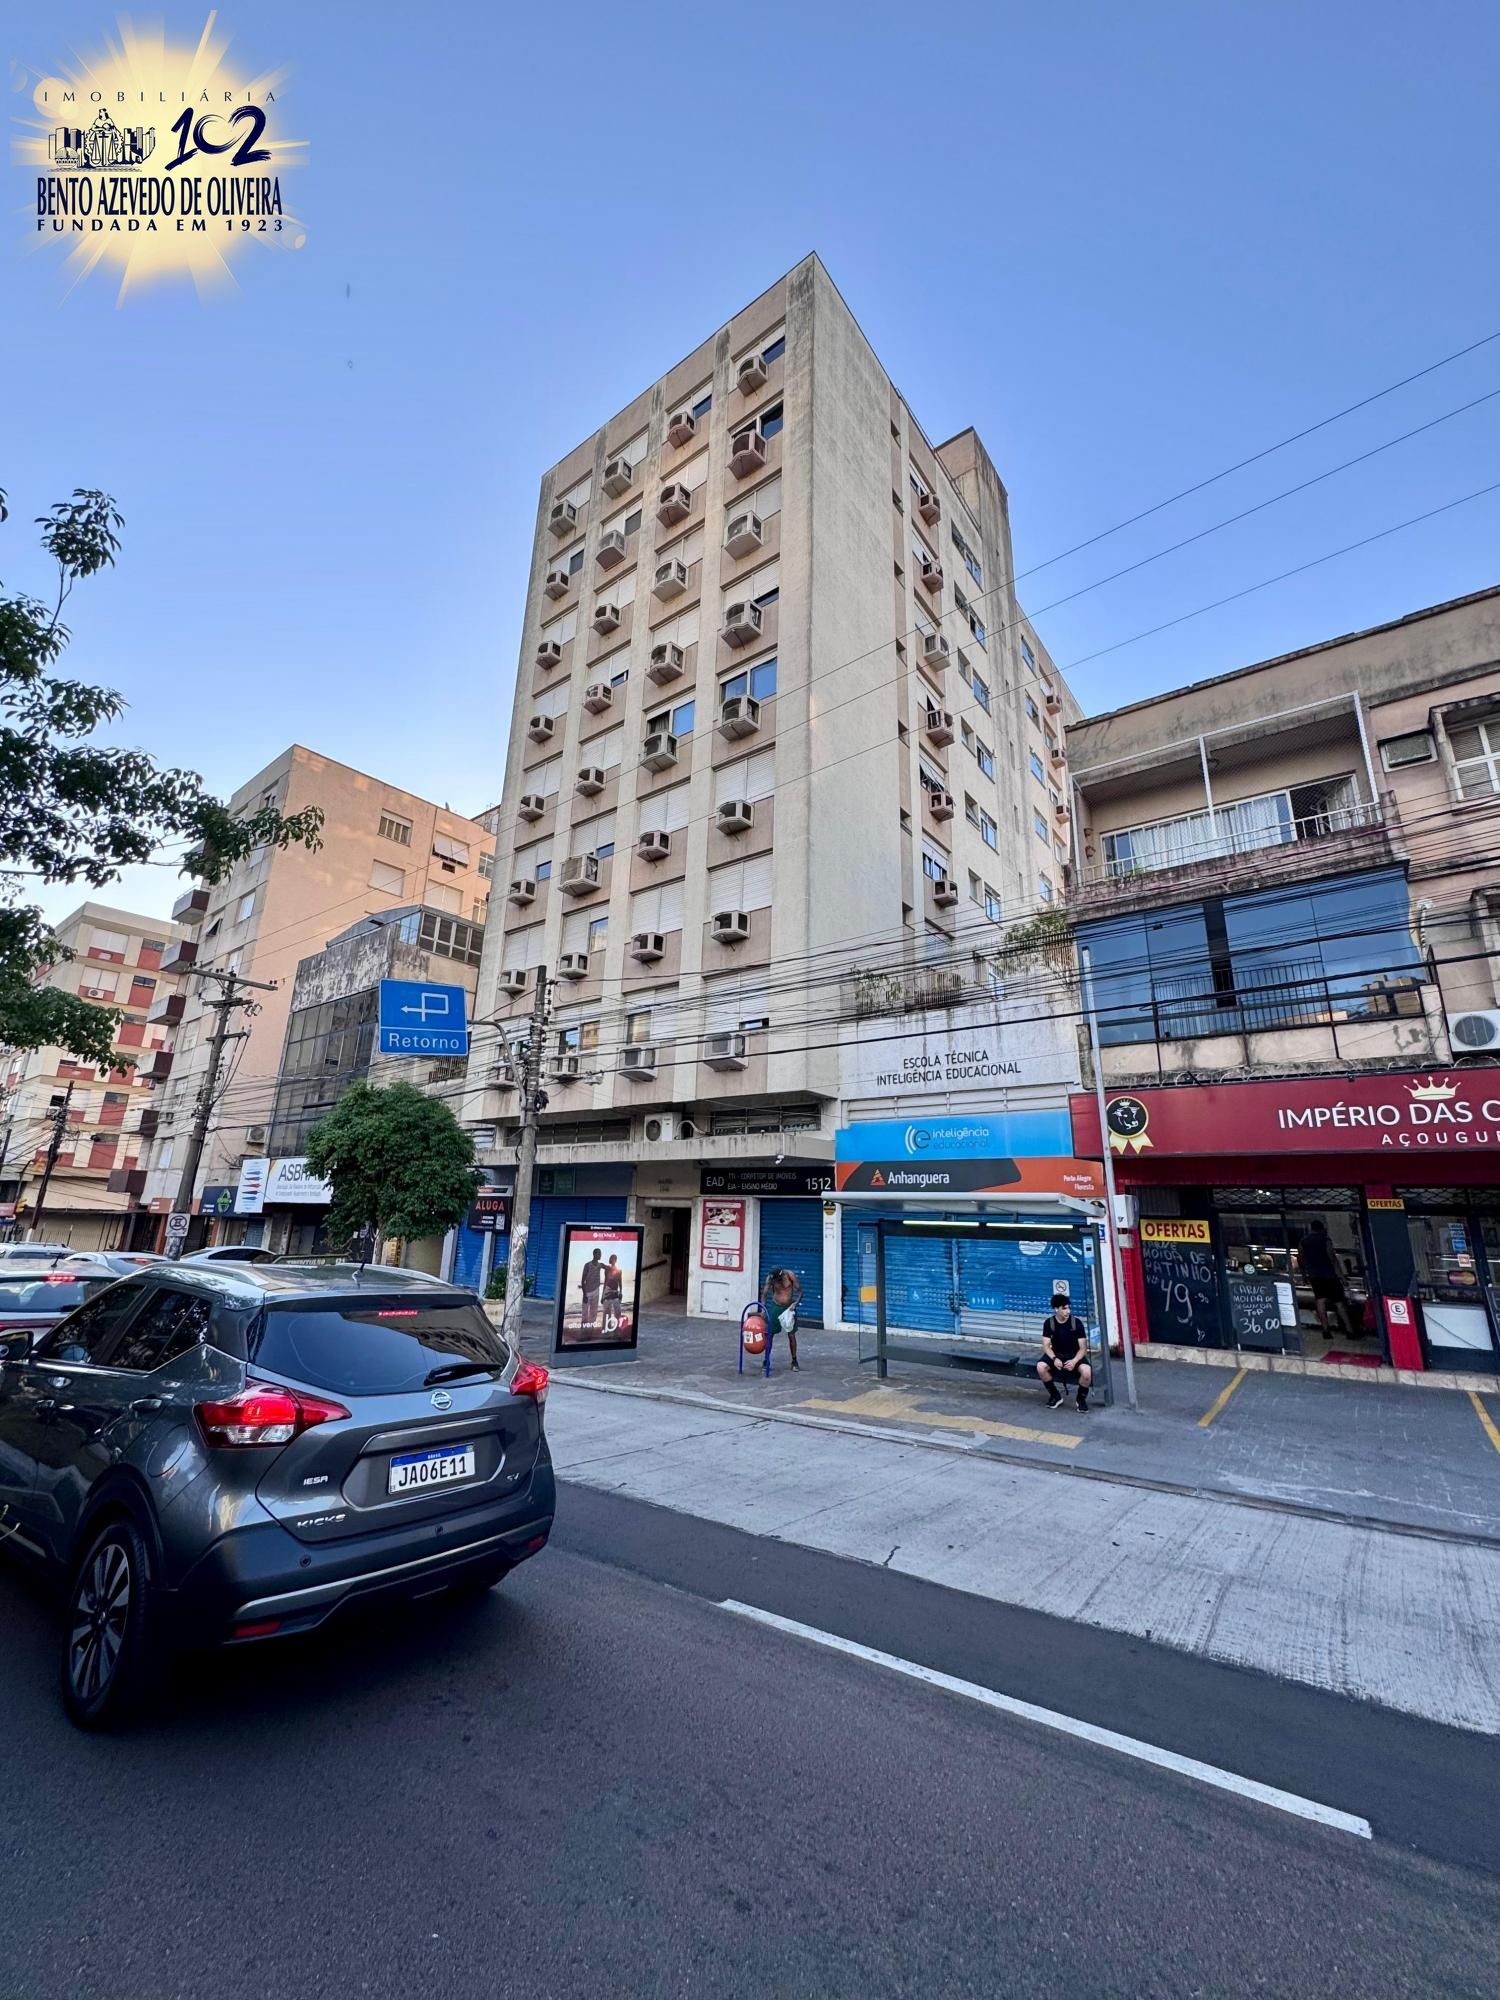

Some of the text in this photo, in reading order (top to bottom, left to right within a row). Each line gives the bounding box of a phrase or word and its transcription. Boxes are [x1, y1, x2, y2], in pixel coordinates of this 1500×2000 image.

[389, 1033, 459, 1049] Retorno
[903, 1049, 989, 1069] ESCOLA TÉCNICA
[876, 1062, 1021, 1086] INTELIGÊNCIA EDUCACIONAL
[1278, 1102, 1400, 1129] IMPÉRIO
[1409, 1101, 1473, 1125] DAS
[932, 1127, 990, 1140] inteligência
[706, 1176, 725, 1187] EAD
[741, 1182, 760, 1190] ENSINO
[806, 1177, 832, 1190] 1512
[888, 1171, 950, 1188] Anhanguera
[475, 1200, 505, 1211] ALUGA
[1370, 1200, 1402, 1208] OFERTAS
[1145, 1222, 1206, 1239] OFERTAS
[1240, 1317, 1280, 1334] 36,00
[303, 1475, 329, 1485] IESA
[297, 1513, 346, 1528] KICKS
